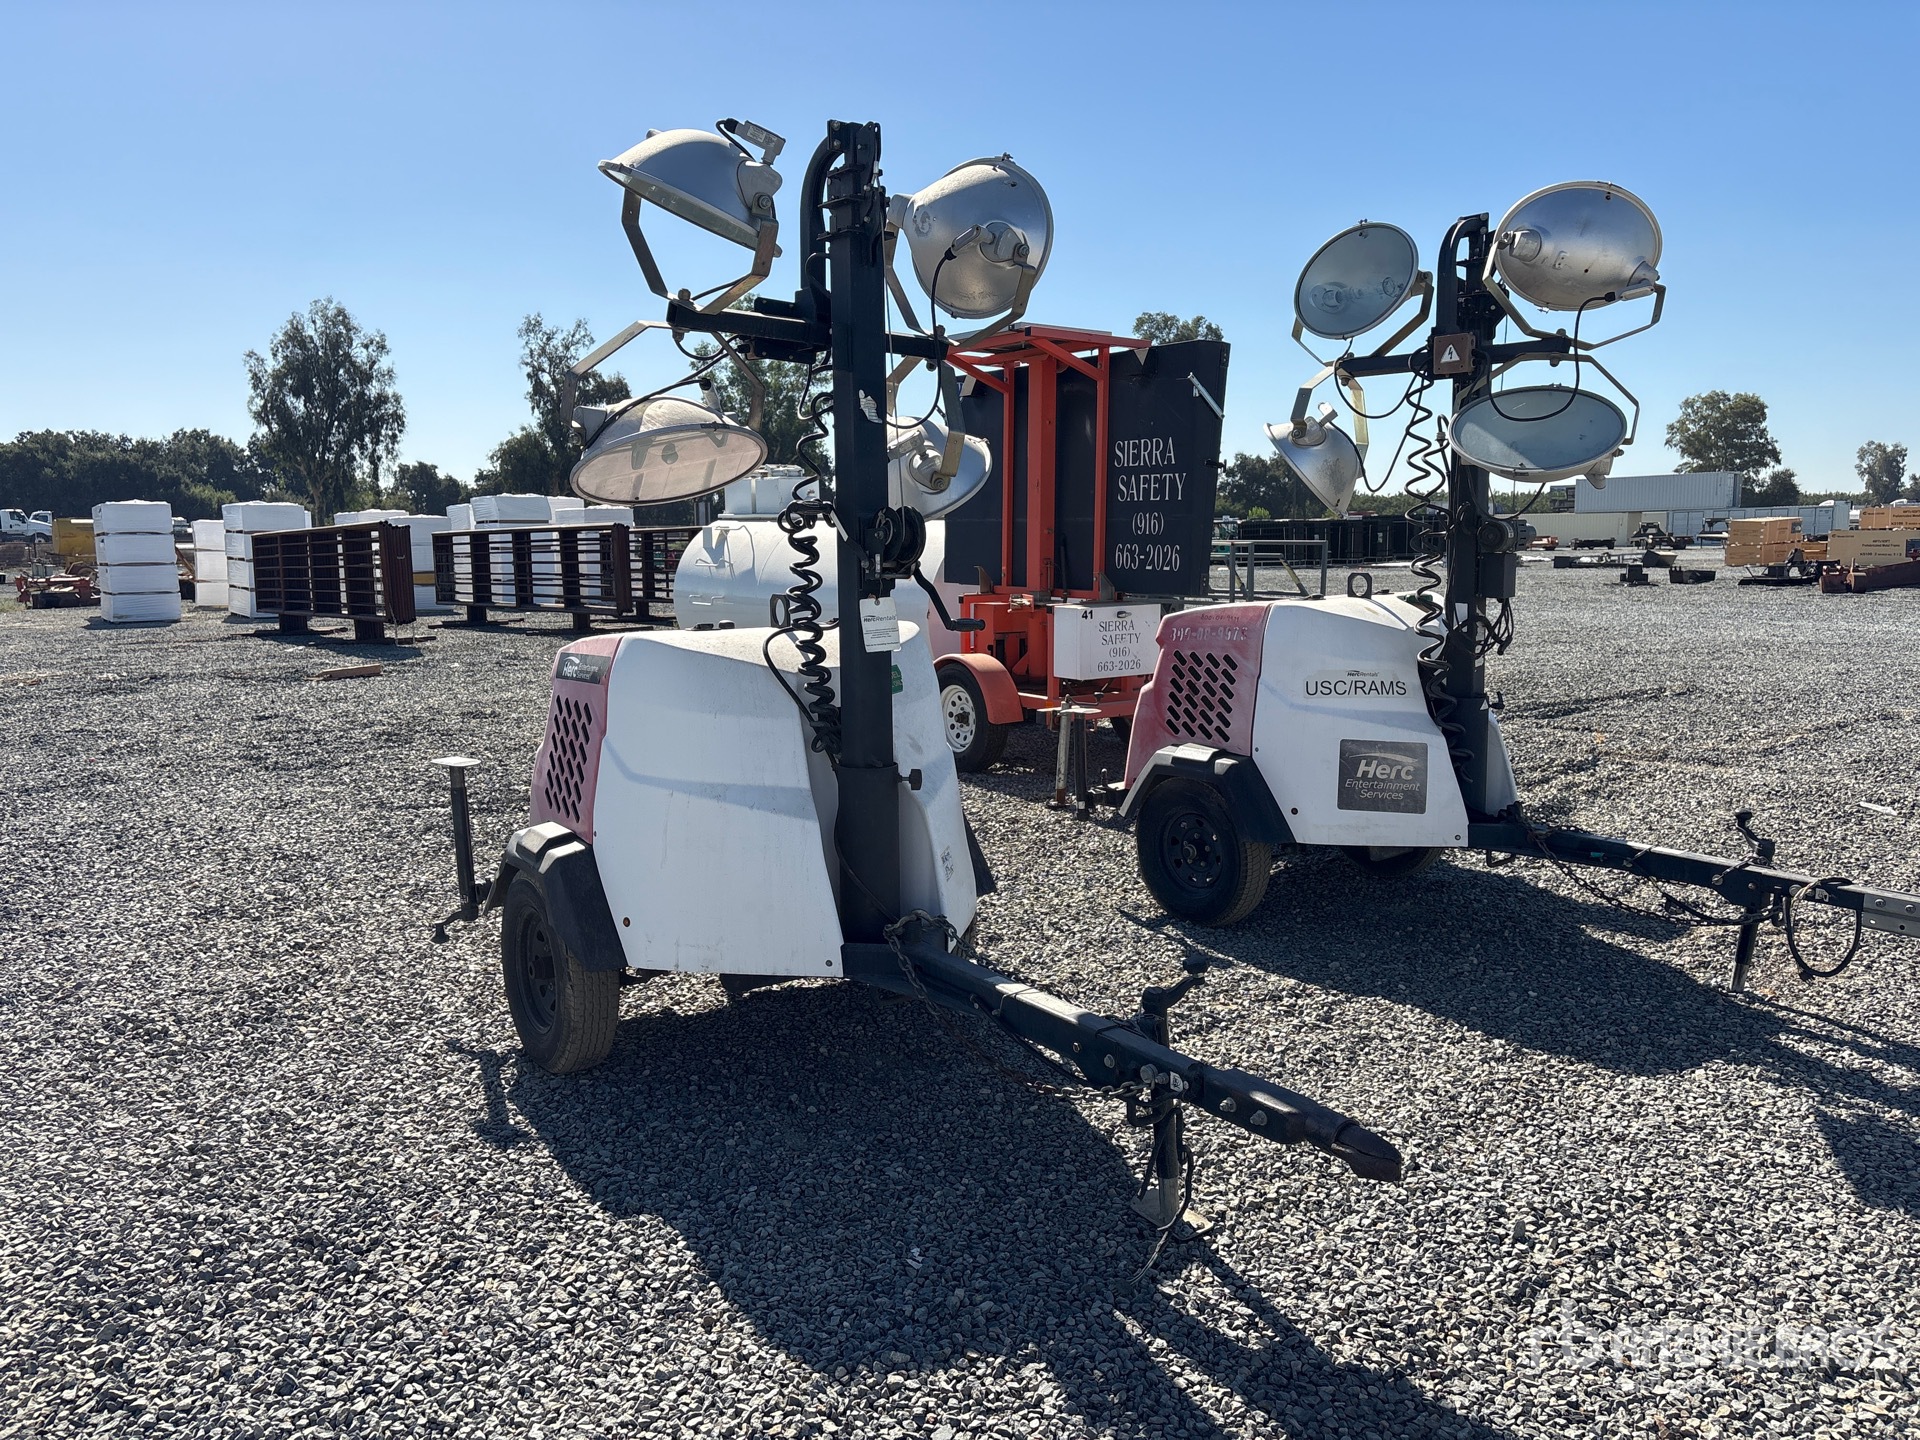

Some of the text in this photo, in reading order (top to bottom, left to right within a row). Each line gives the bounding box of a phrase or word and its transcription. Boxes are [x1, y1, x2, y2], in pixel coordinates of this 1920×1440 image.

[1114, 436, 1176, 467] SIERRA
[1117, 473, 1187, 502] SAFETY
[1132, 512, 1164, 535] (916)
[1115, 543, 1180, 572] 663-2026
[1081, 609, 1093, 620] 41
[1098, 620, 1135, 632] SIERRA
[1101, 632, 1141, 646] SAFETY
[1109, 647, 1130, 658] (916)
[1097, 659, 1141, 672] 663-2026
[1305, 680, 1407, 696] USC/RAMS
[1356, 759, 1416, 780] Herc
[1345, 778, 1421, 792] Entertainment
[1359, 789, 1404, 800] Services
